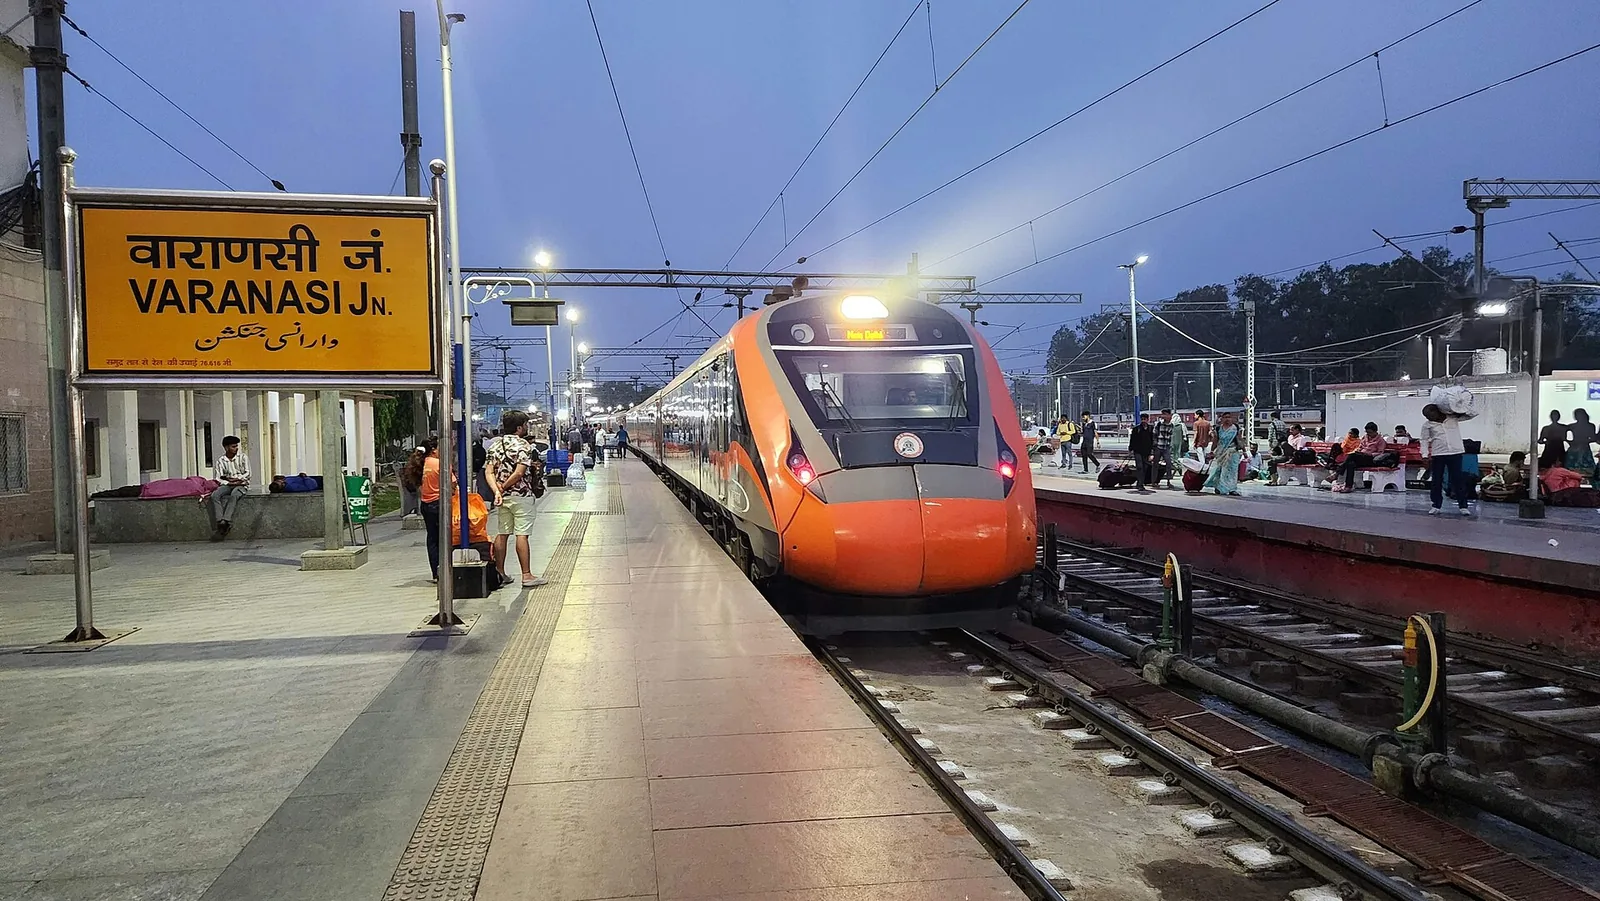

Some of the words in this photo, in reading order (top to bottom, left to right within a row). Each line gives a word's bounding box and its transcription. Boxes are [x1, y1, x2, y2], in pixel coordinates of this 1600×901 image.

[126, 223, 320, 273] वाराणसी
[341, 228, 391, 273] जं.
[128, 278, 340, 315] VARANASI
[151, 358, 163, 366] रेल
